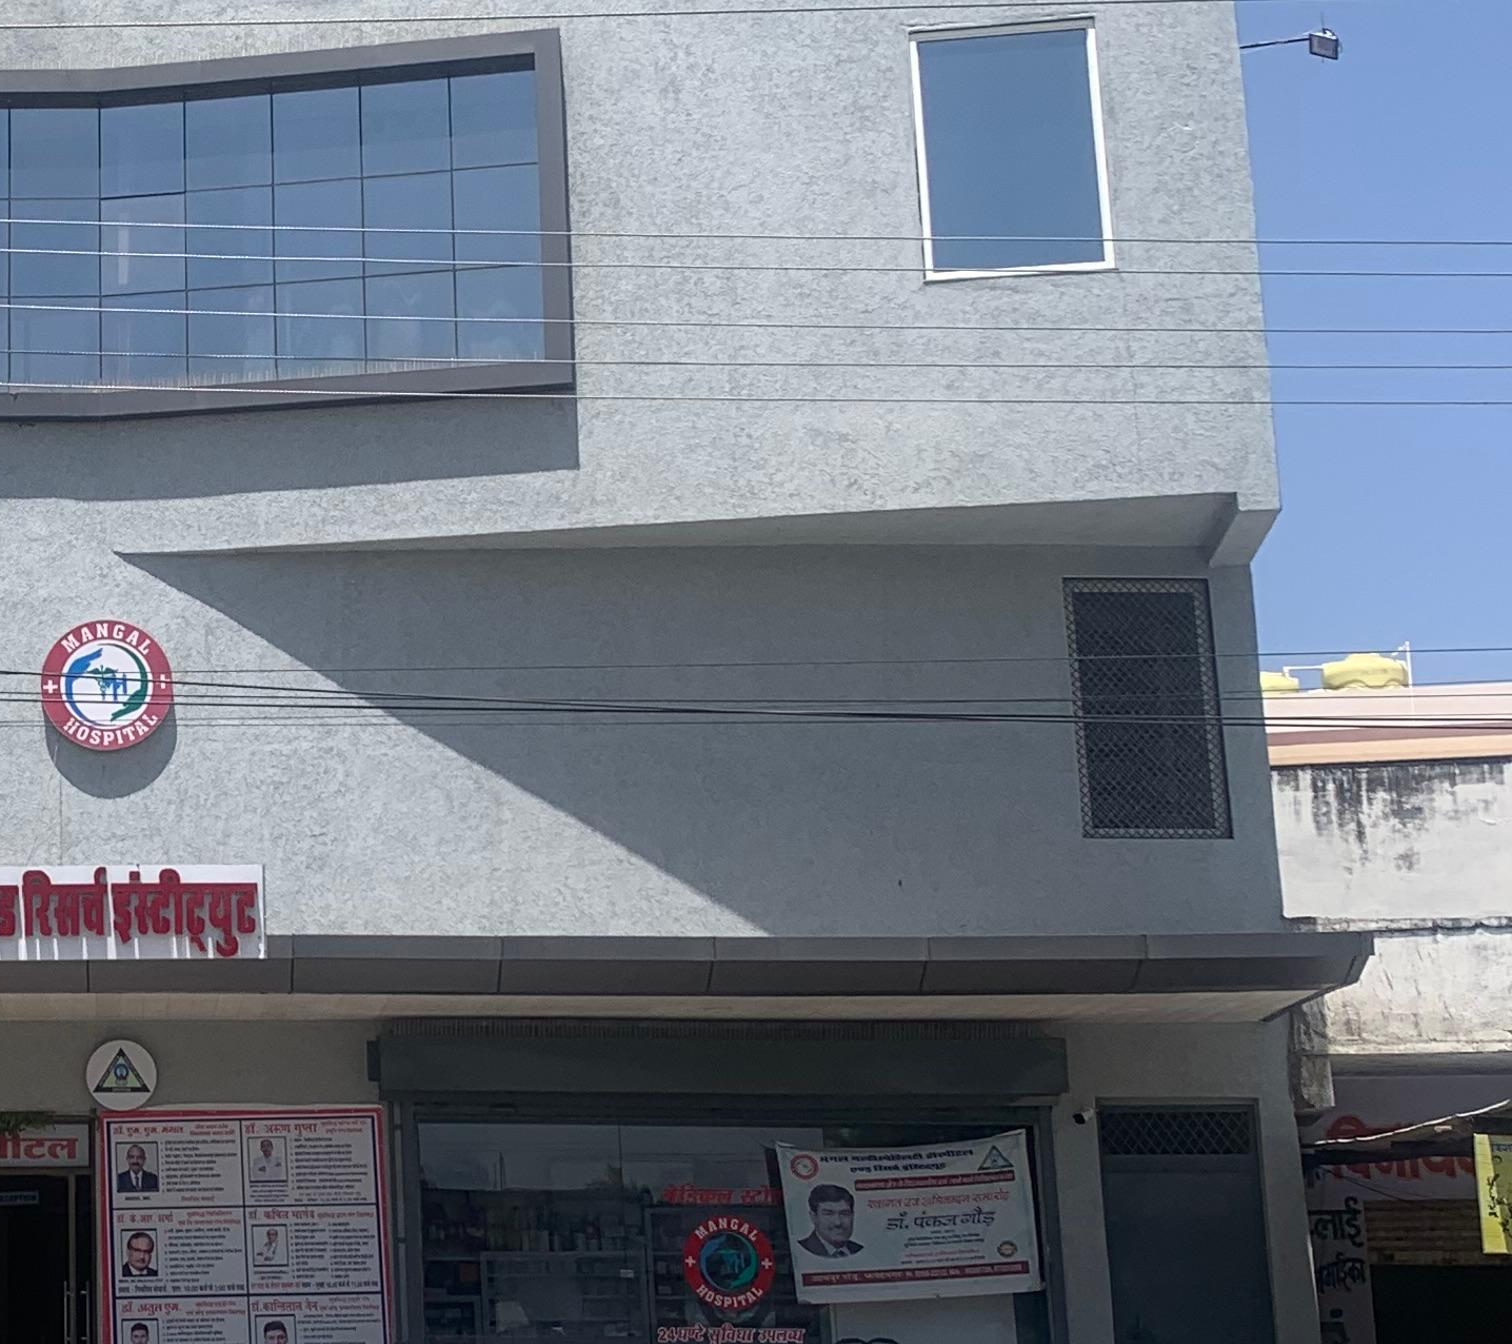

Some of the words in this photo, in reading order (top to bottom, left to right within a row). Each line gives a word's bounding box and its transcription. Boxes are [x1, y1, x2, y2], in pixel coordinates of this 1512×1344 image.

[60, 622, 153, 656] MANGAL
[62, 713, 158, 746] HOSPITAL
[21, 866, 108, 938] रिसर्च
[693, 1217, 760, 1241] MANGAL
[886, 1210, 909, 1230] डॉ.
[913, 1209, 957, 1229] पंकज
[695, 1284, 763, 1308] HOSPITAL
